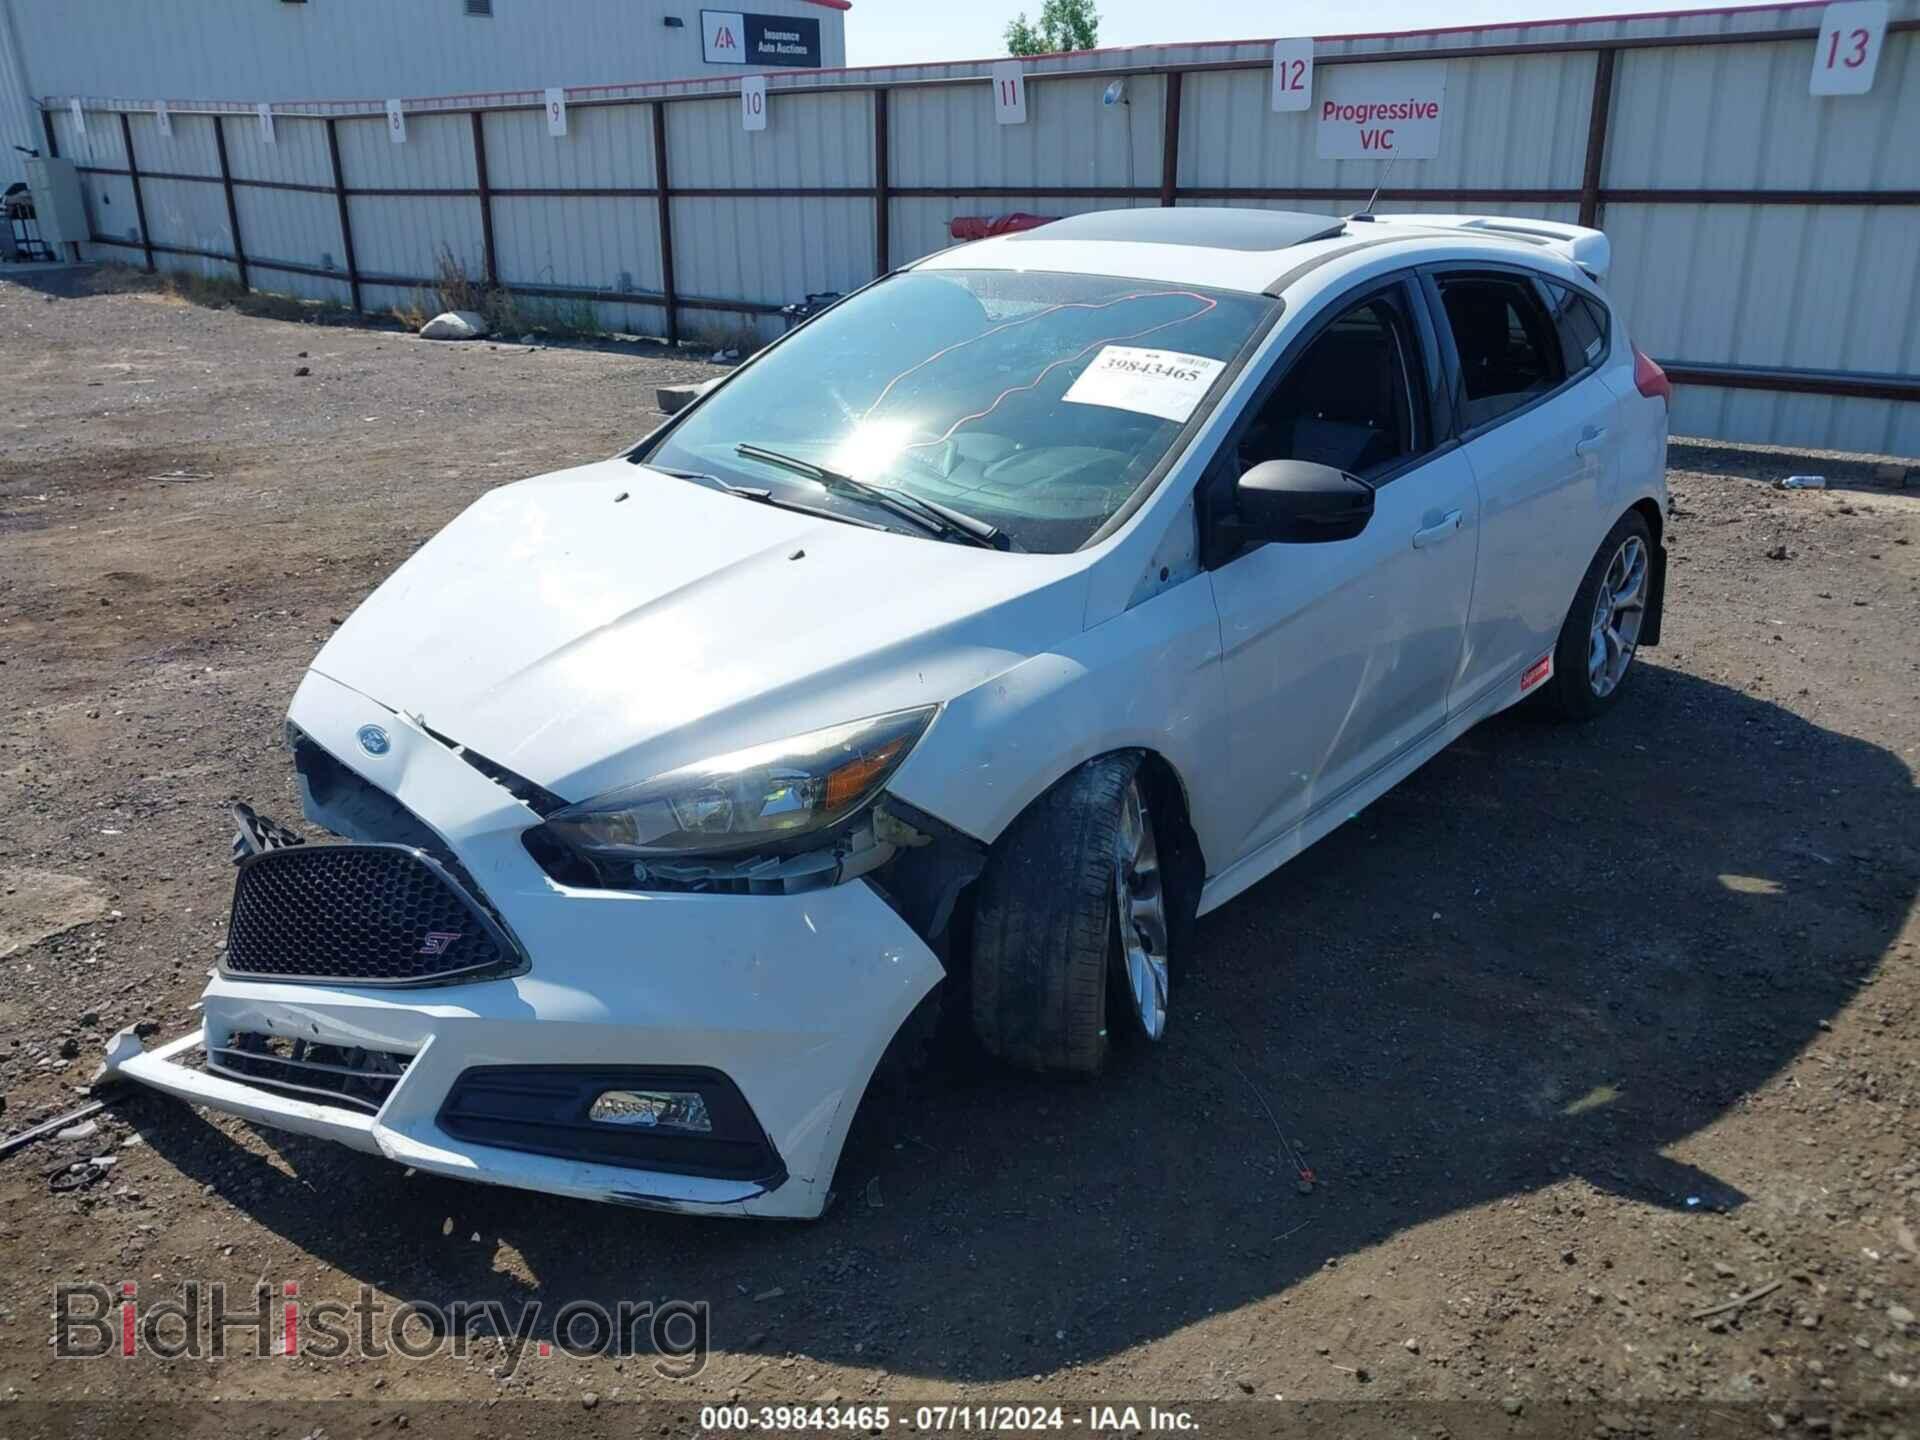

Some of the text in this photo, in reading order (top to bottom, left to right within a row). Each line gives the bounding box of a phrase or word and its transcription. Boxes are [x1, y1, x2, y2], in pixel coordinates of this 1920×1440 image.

[764, 28, 800, 41] Insurance
[759, 41, 808, 55] Auto Auctions
[1827, 28, 1869, 69] 13
[1280, 59, 1306, 91] 12
[746, 91, 762, 115] 10
[1001, 79, 1017, 106] 11
[393, 111, 400, 130] 8
[551, 101, 560, 122] 9
[1322, 98, 1439, 124] Progressive
[1360, 129, 1395, 149] VIC
[1102, 358, 1201, 382] 39843465
[420, 931, 461, 954] ST
